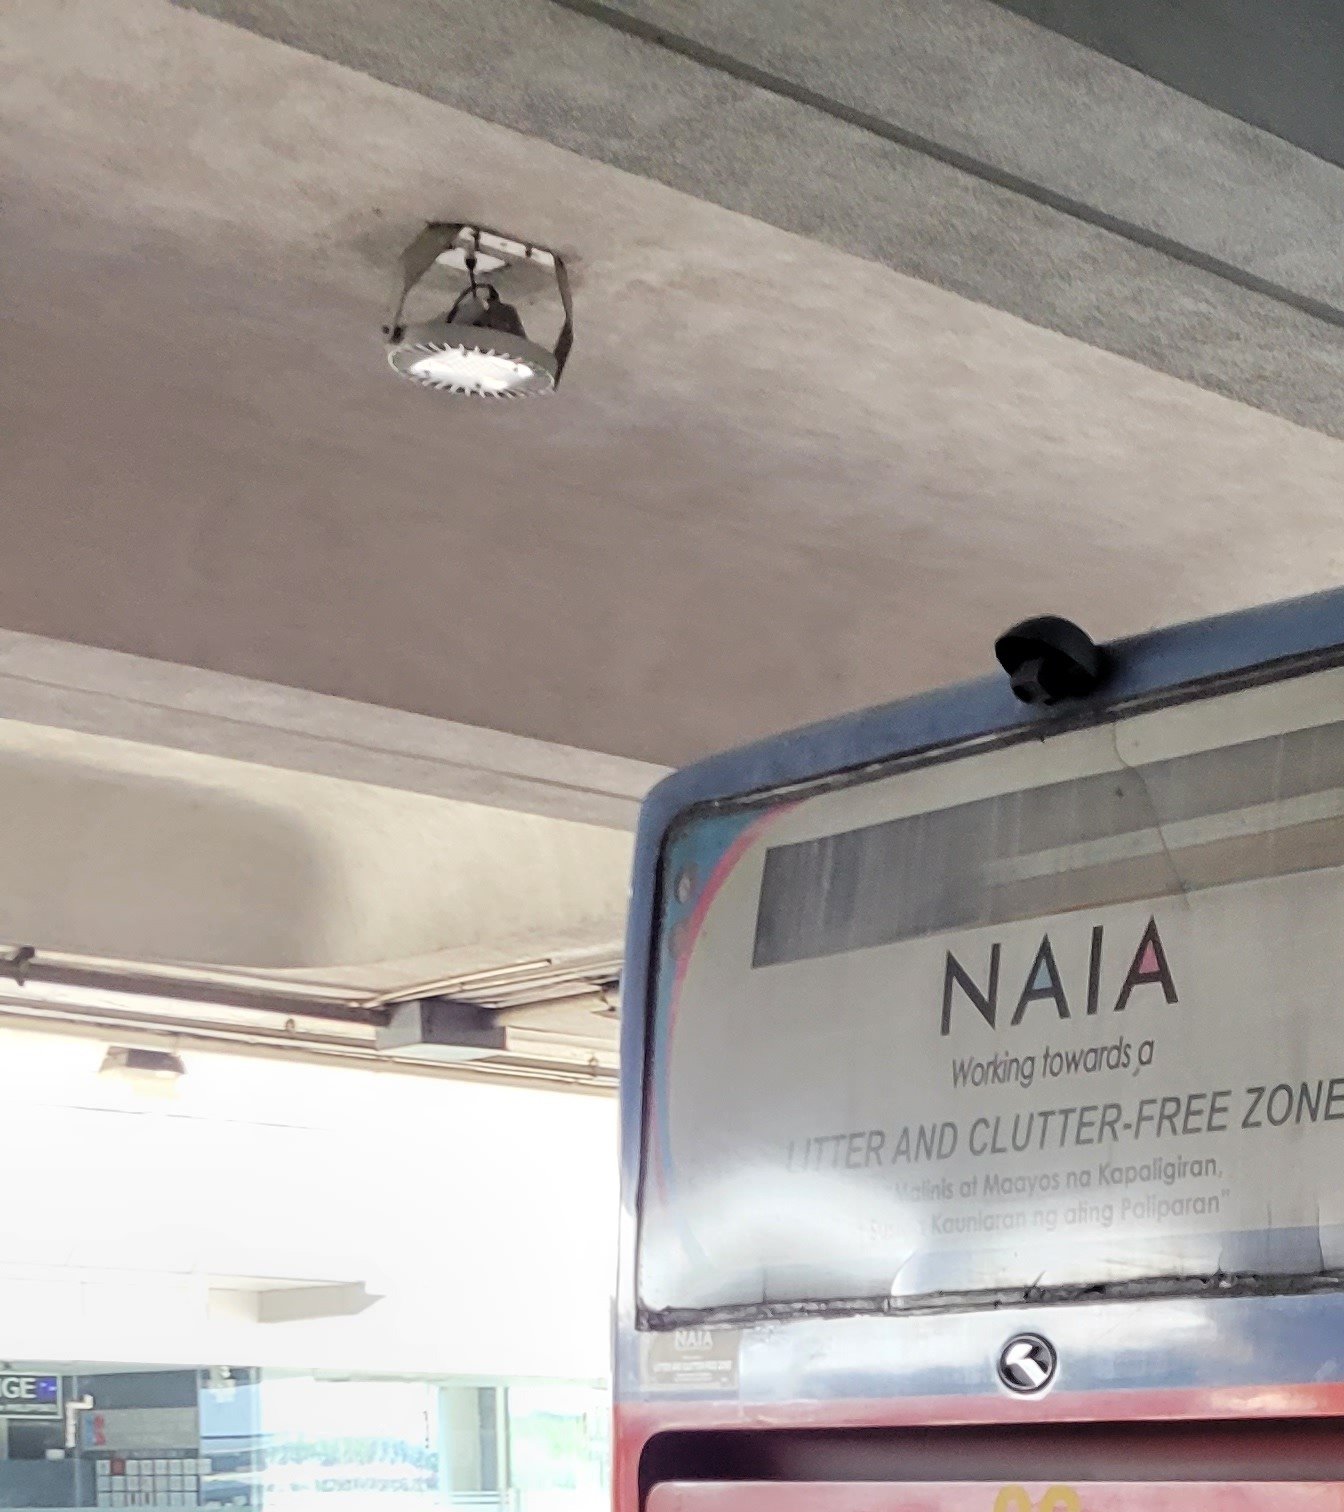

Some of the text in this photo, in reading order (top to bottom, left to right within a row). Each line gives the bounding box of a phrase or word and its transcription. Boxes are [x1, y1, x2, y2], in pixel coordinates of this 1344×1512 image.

[940, 914, 1179, 1036] NAIA
[952, 1035, 1155, 1088] Working towards a
[786, 1127, 885, 1172] LITTER
[892, 1120, 959, 1165] AND
[968, 1090, 1231, 1157] CLUTTER-FREE
[959, 1179, 978, 1200] at
[983, 1173, 1060, 1197] Maayos
[1065, 1171, 1092, 1188] na
[1098, 1156, 1224, 1189] Kapaligiran,
[931, 1210, 1027, 1236] Kaunlaran
[1032, 1209, 1058, 1233] ng
[0, 1377, 37, 1398] GE
